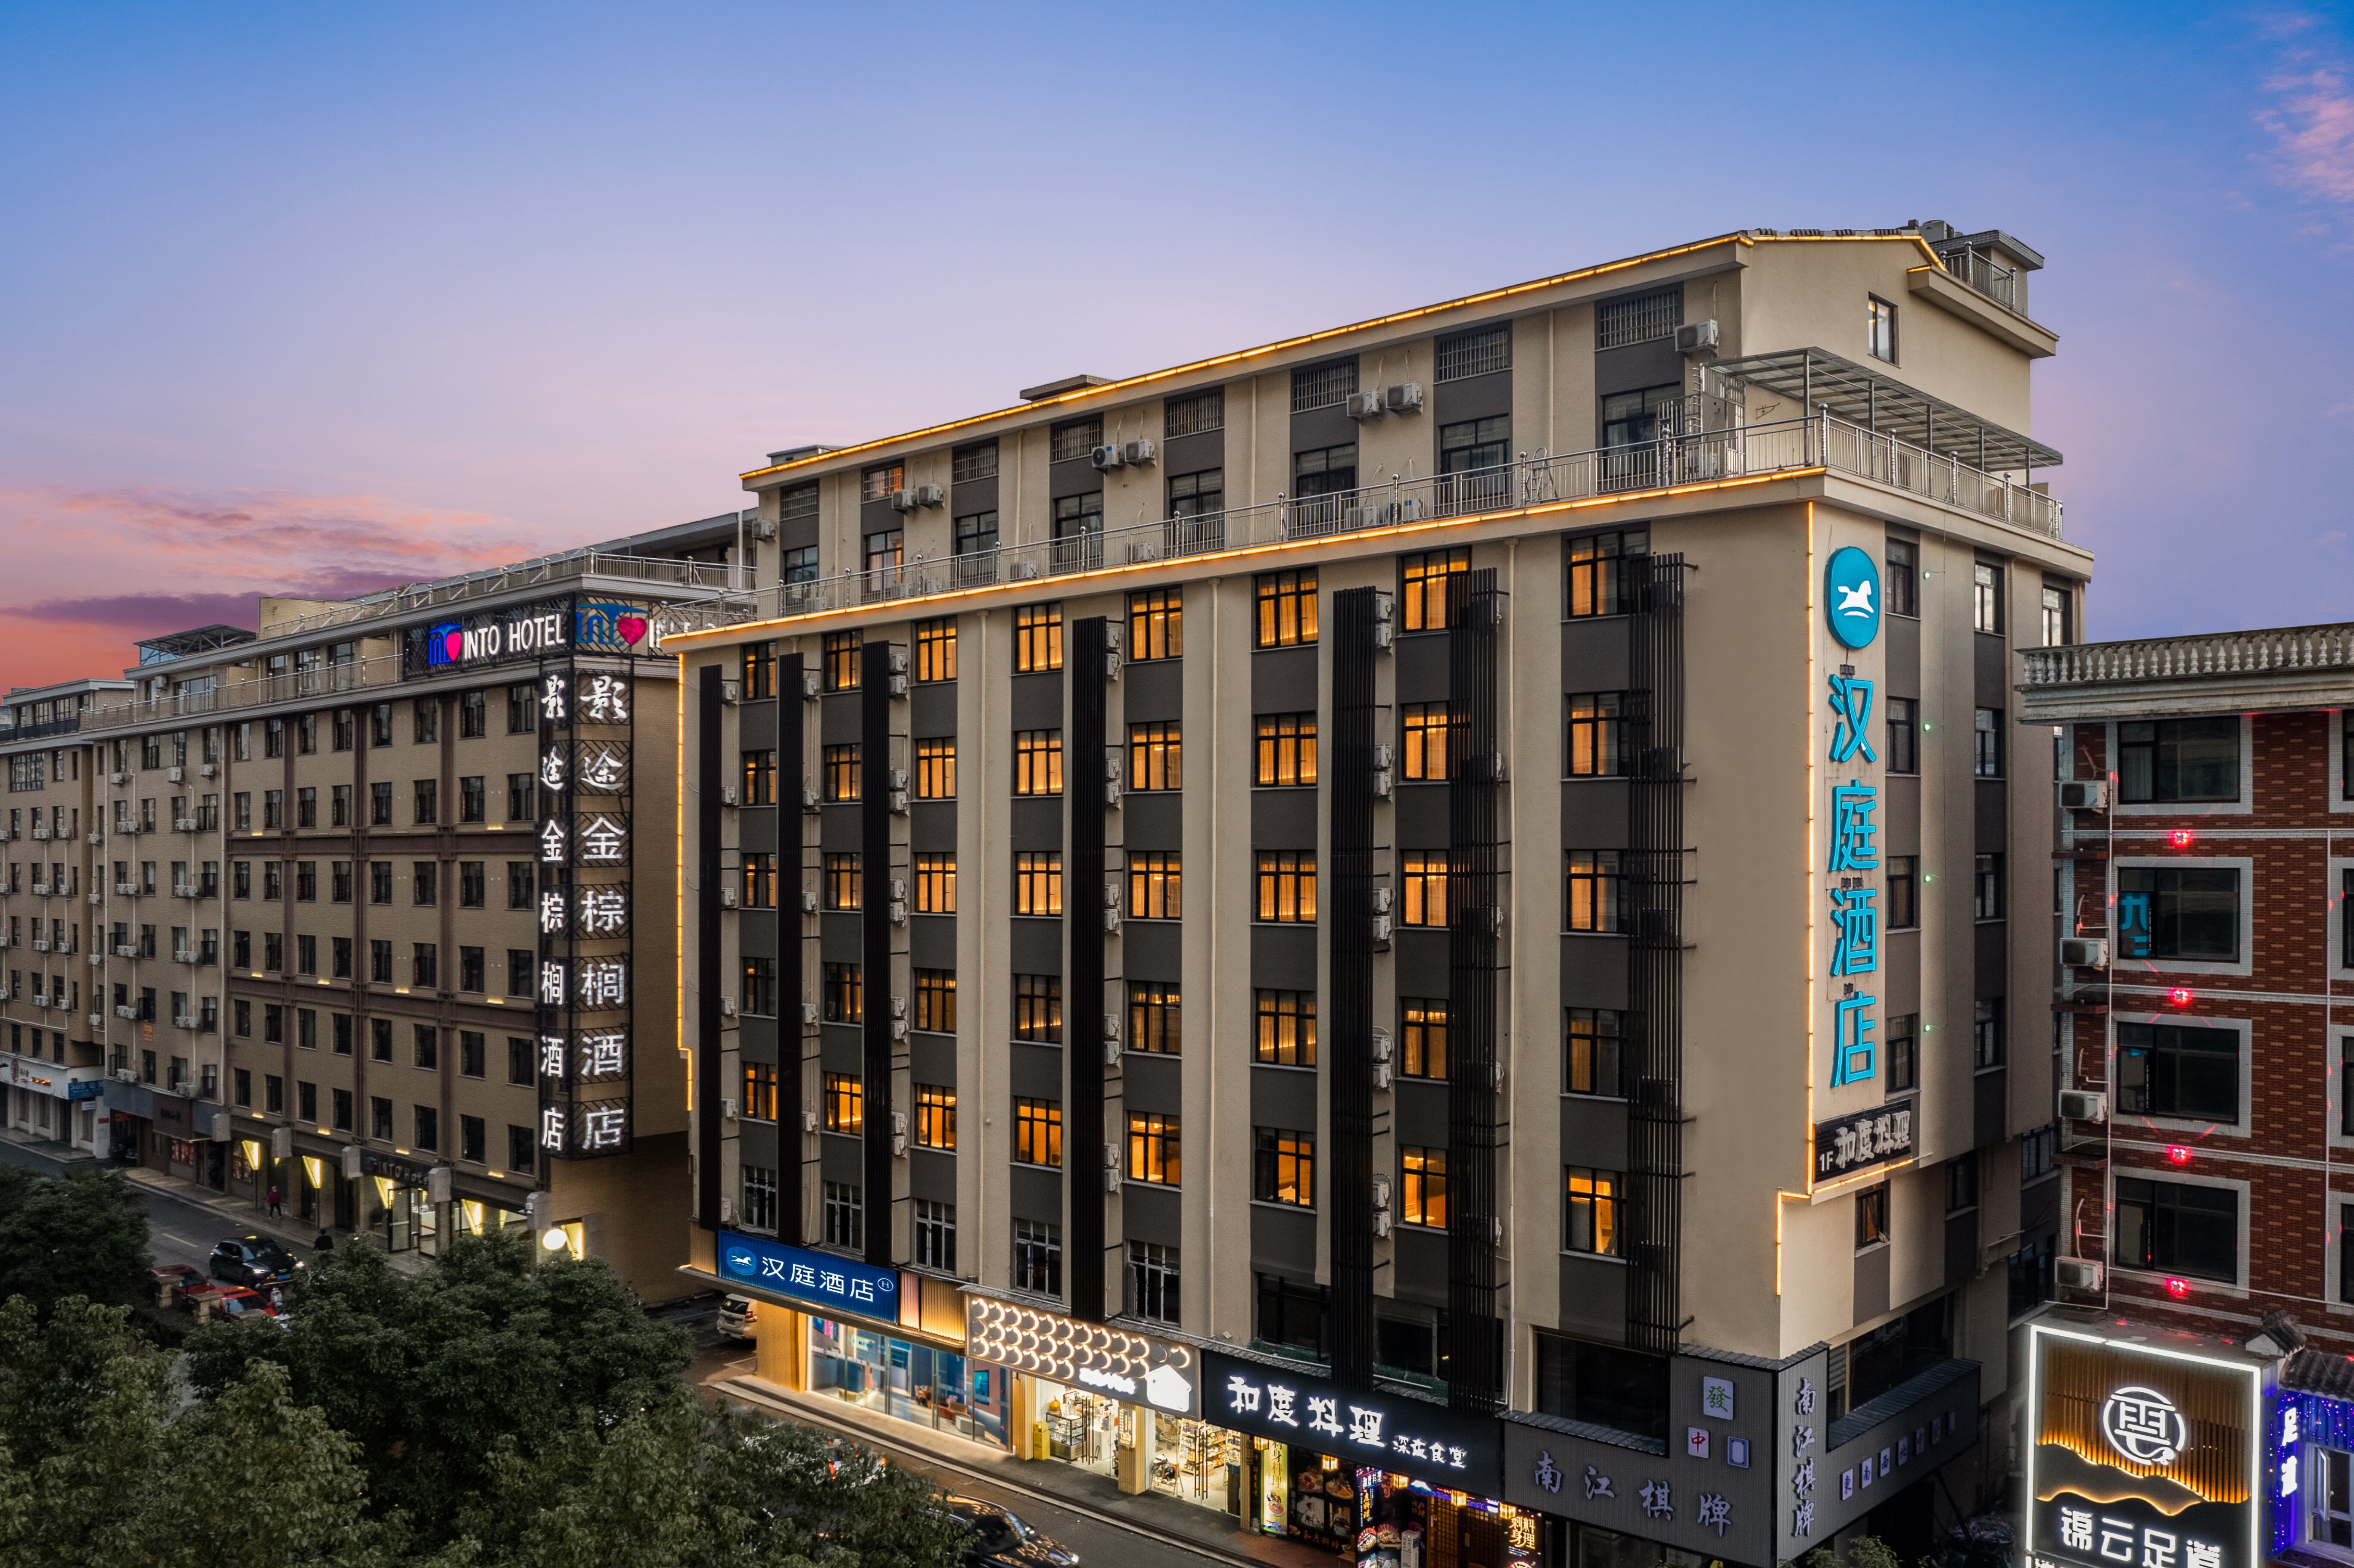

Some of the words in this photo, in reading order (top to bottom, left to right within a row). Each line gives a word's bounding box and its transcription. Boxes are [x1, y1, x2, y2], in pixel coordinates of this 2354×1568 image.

[464, 625, 500, 660] INTO
[509, 614, 566, 652] HOTEL
[540, 675, 565, 1151] 影途金棕榈酒店
[580, 675, 627, 1150] 影途金棕榈酒店
[1828, 673, 1878, 1088] 汉庭酒店
[378, 1161, 402, 1178] INTO
[404, 1167, 429, 1185] Hote
[1819, 1151, 1833, 1172] 1F
[1834, 1110, 1911, 1169] 和度料理
[762, 1256, 874, 1302] 汉庭酒店
[1227, 1376, 1386, 1447] 和度料理
[1705, 1384, 1731, 1412] 發
[1691, 1431, 1706, 1454] 中
[1792, 1378, 1816, 1537] 南江棋牌
[1534, 1450, 1733, 1538] 南江棋牌
